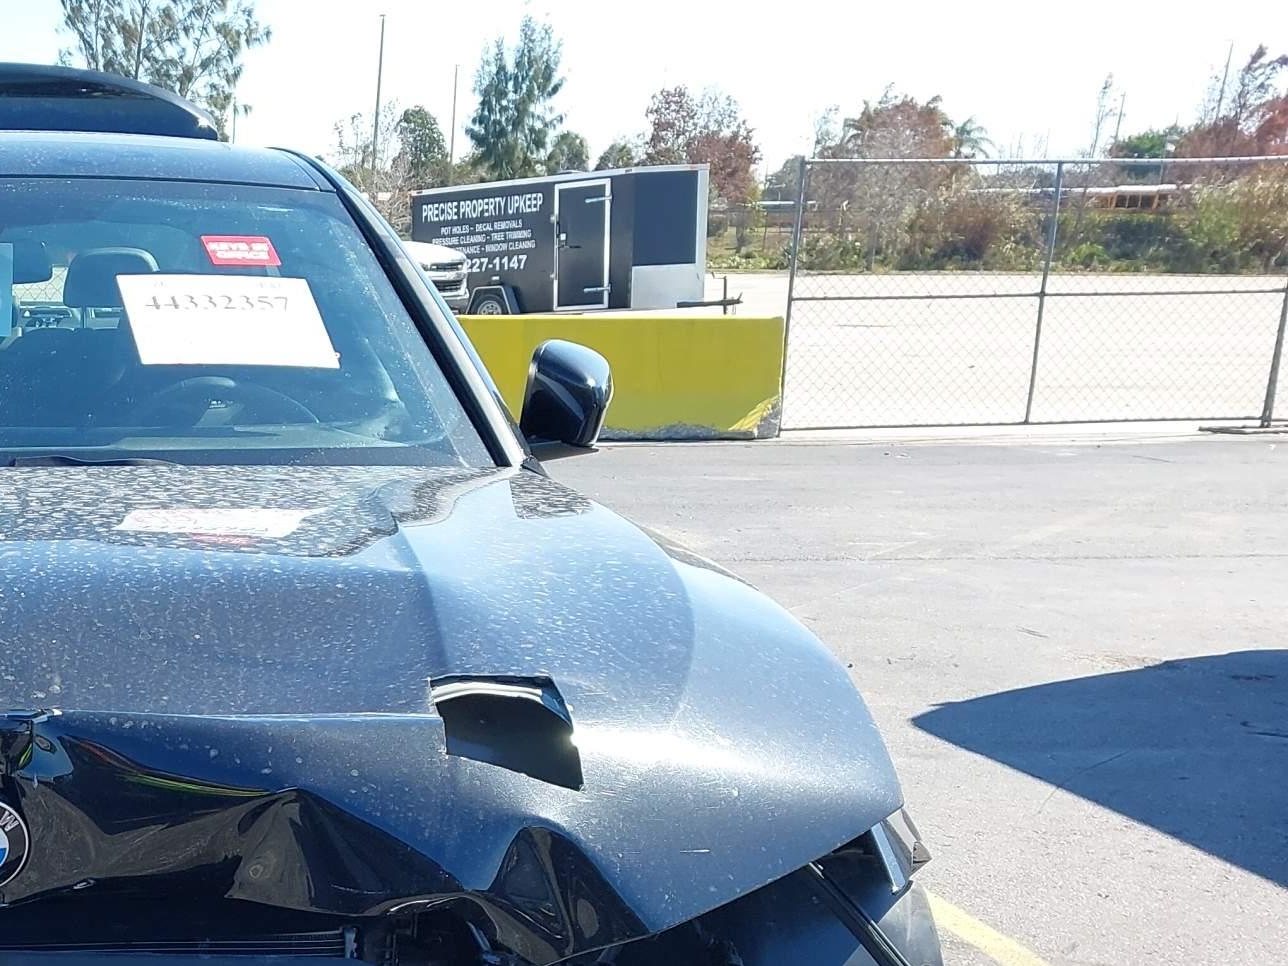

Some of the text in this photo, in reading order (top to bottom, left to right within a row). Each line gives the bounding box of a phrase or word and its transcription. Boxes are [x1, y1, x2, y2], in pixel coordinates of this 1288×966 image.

[422, 192, 544, 222] PRECISE PROPERTY UPKEEP
[440, 226, 451, 236] POT
[452, 224, 470, 235] HOLES
[475, 222, 493, 232] DECAL
[494, 219, 523, 230] REMOVALS
[432, 236, 460, 246] PRESSURE
[460, 234, 486, 245] CLEANING
[491, 232, 505, 242] TREE
[506, 229, 532, 240] TRIMMING
[485, 242, 508, 253] WINDOW
[509, 240, 536, 251] CLEANING
[144, 294, 289, 312] 44332357
